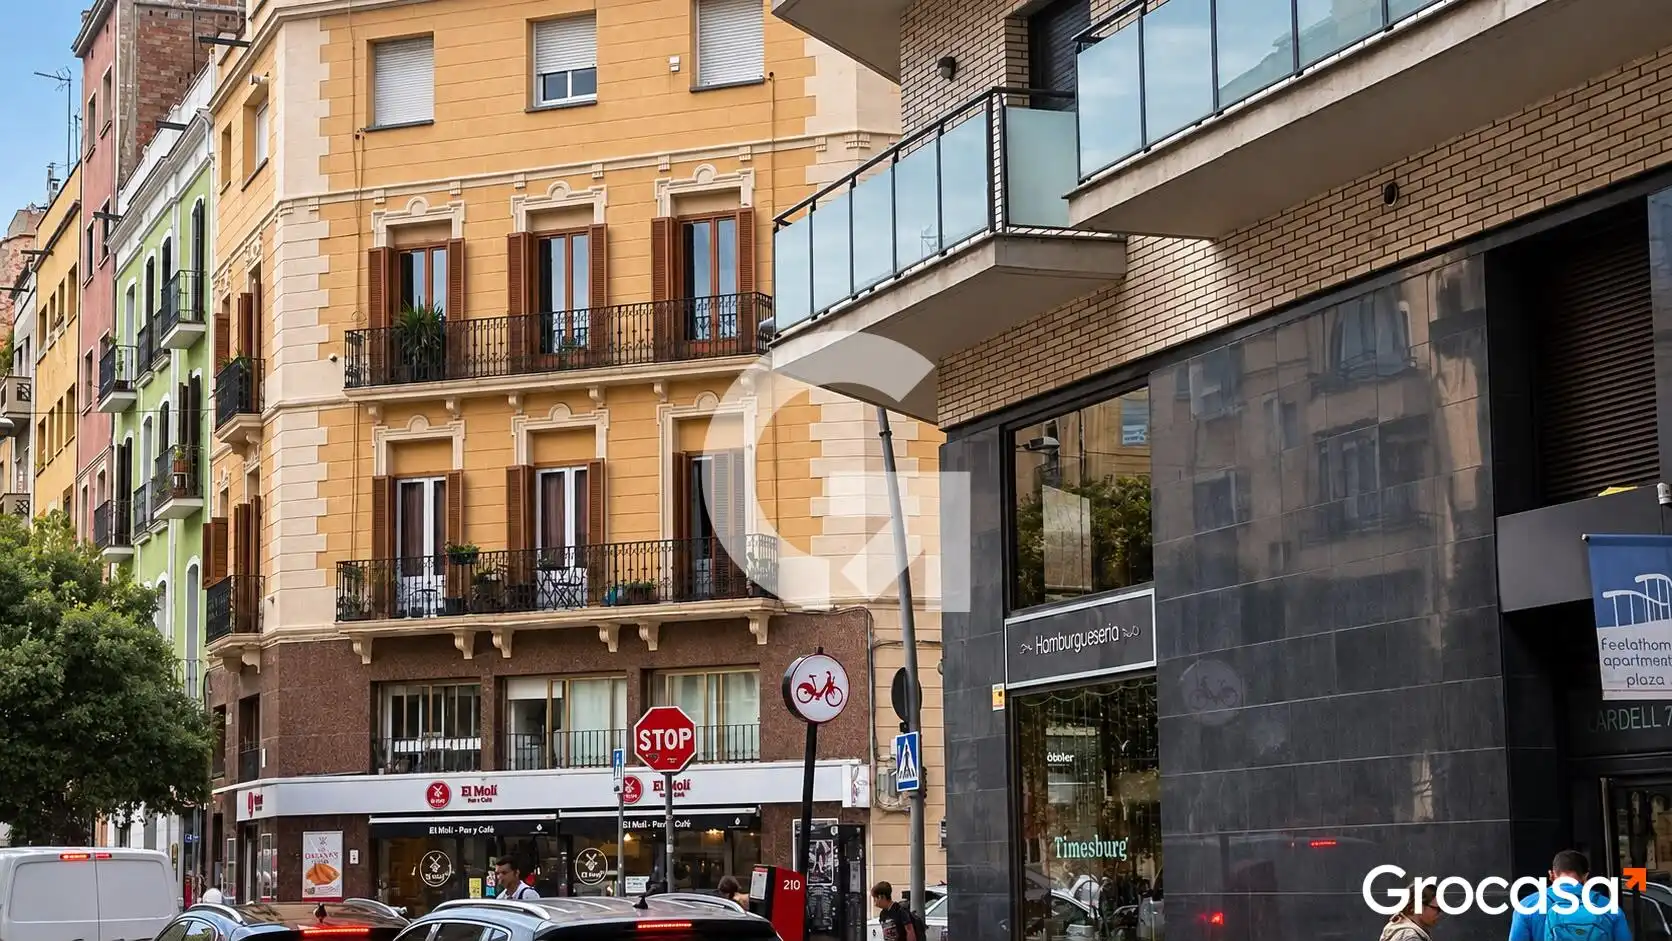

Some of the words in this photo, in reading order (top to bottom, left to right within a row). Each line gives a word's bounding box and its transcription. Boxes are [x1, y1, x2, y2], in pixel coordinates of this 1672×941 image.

[1626, 673, 1665, 688] plaza
[1589, 704, 1661, 732] ARDELL
[639, 727, 692, 751] STOP
[461, 786, 472, 797] El
[653, 780, 664, 791] El
[429, 826, 438, 835] El
[783, 879, 801, 891] 210
